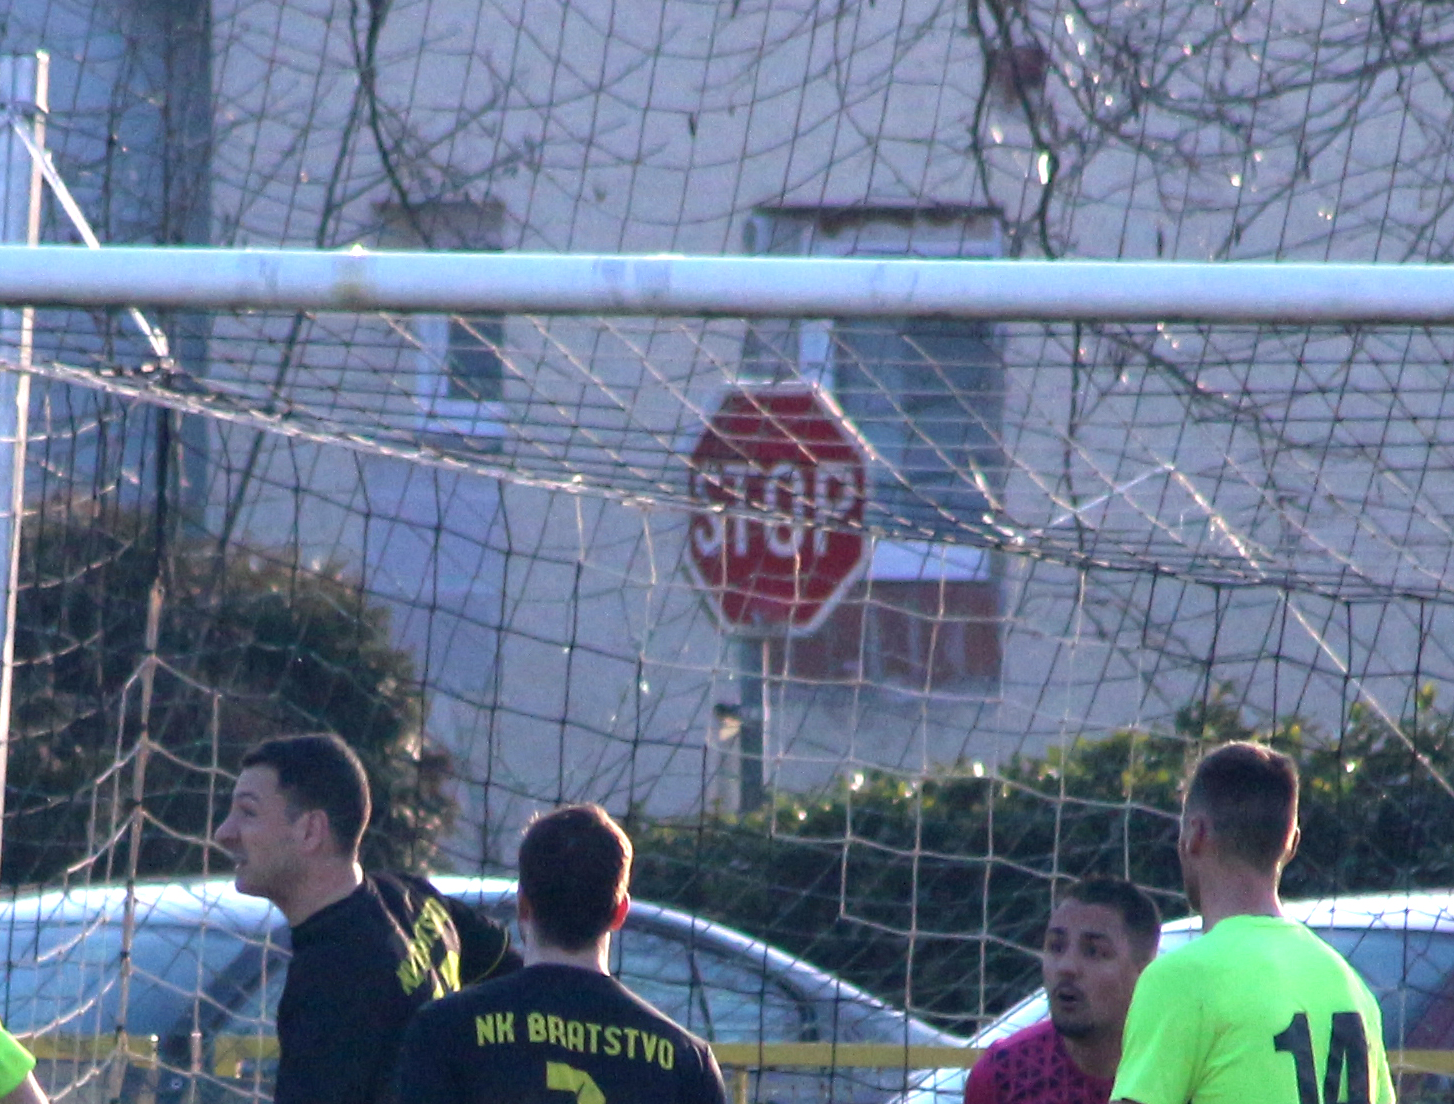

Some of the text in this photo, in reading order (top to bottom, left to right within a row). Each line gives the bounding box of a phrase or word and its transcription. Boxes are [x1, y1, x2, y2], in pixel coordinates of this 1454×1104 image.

[694, 460, 859, 557] STOP
[476, 1012, 674, 1070] NK BRATSTVO
